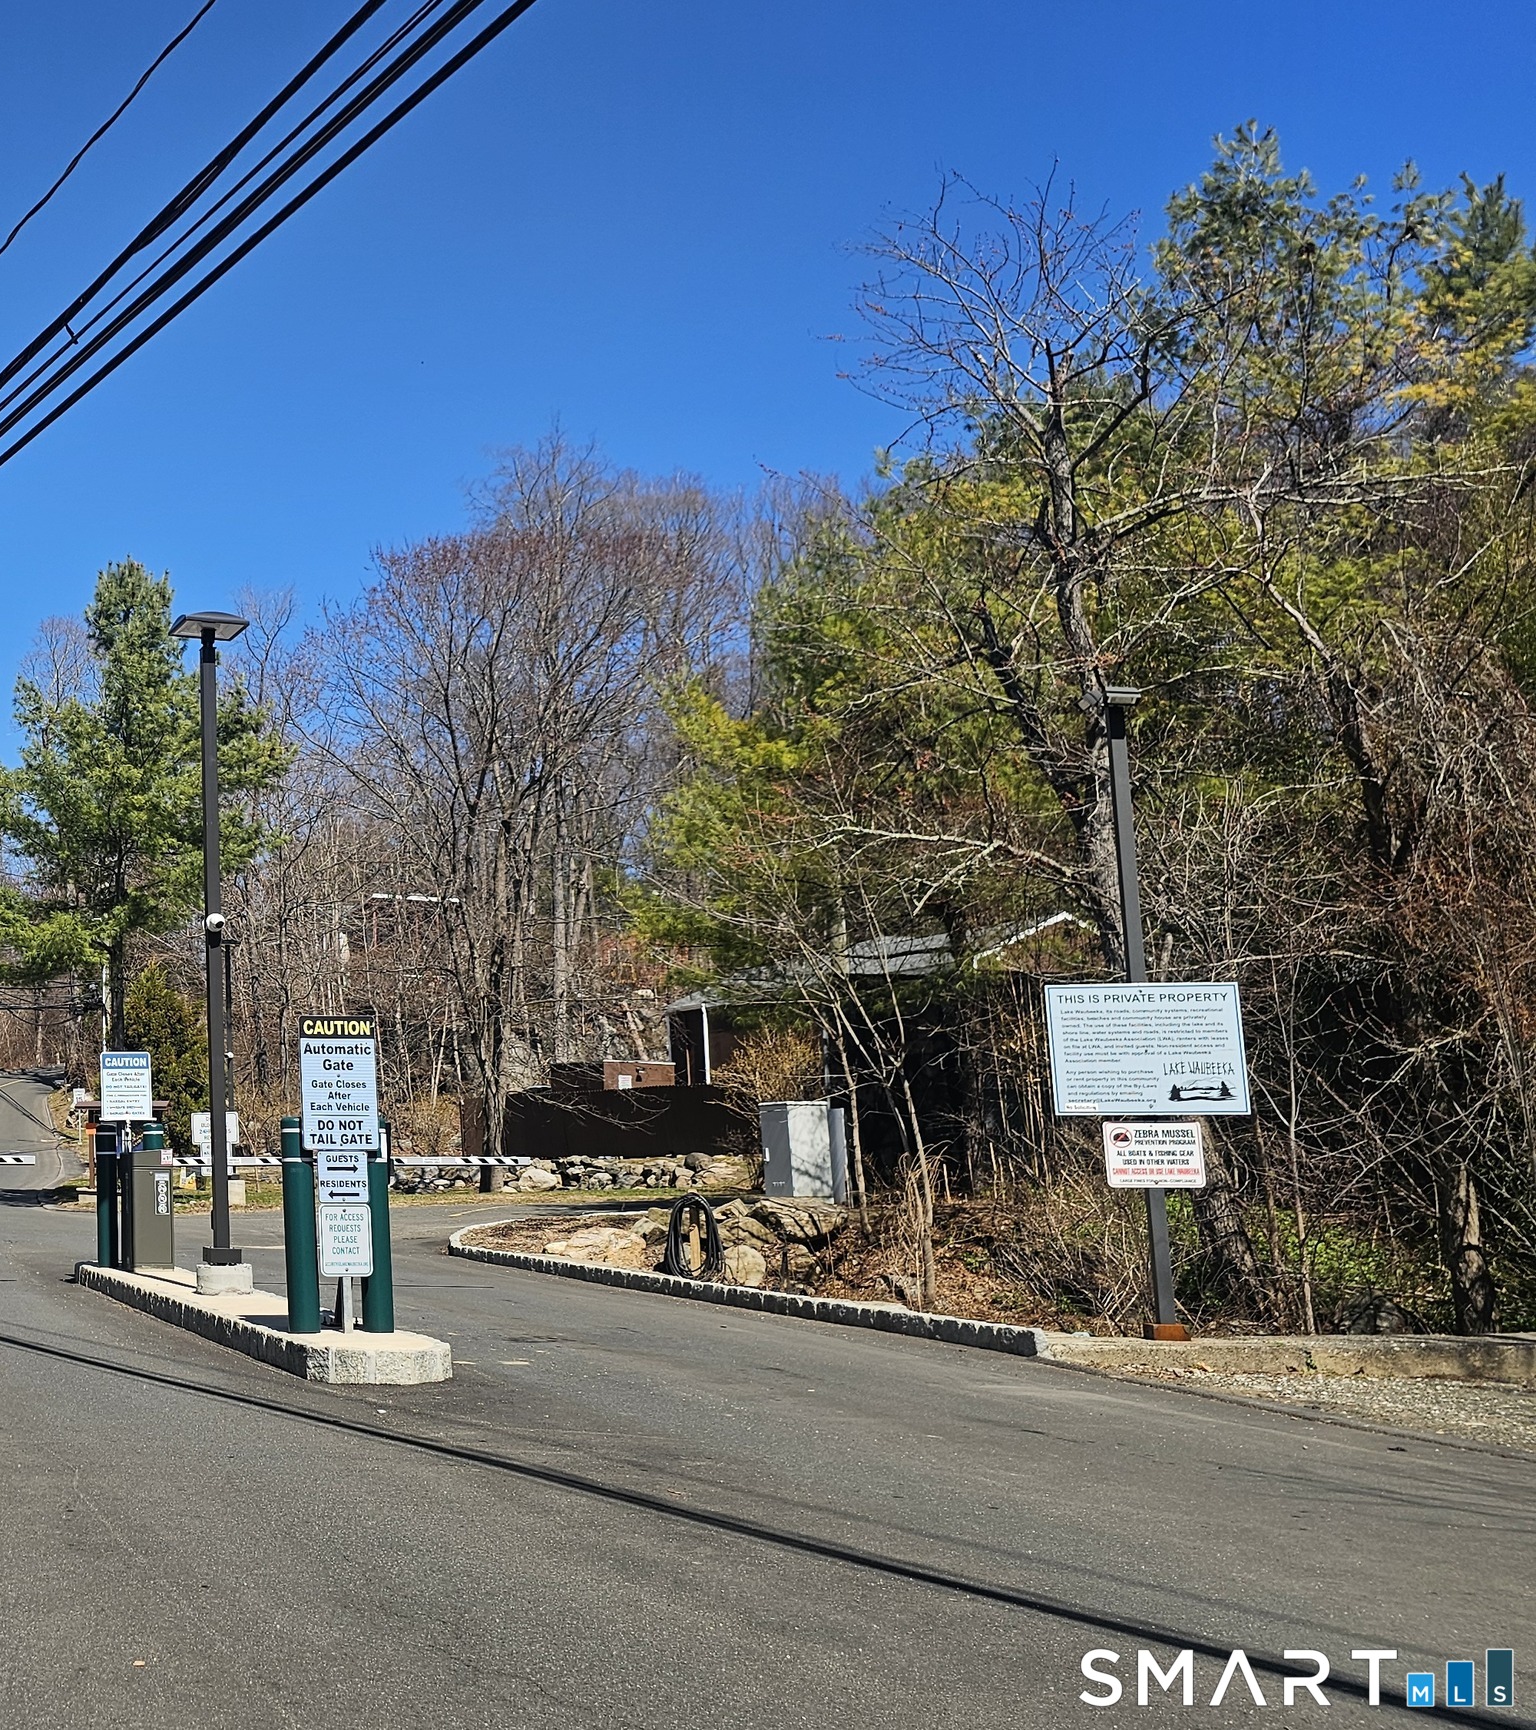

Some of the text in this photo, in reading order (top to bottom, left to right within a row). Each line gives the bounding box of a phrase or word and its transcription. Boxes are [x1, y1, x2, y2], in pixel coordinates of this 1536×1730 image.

[1057, 992, 1228, 1004] THIS IS PRIVATE PROPERTY
[303, 1020, 370, 1036] CAUTION
[304, 1043, 371, 1055] Automatic
[105, 1057, 146, 1067] CAUTION
[323, 1059, 354, 1071] Gate
[1163, 1061, 1235, 1075] LAKE WAUBEEKA
[312, 1080, 366, 1089] Gate Closes
[328, 1091, 351, 1100] After
[310, 1102, 370, 1111] Each Vehicle
[318, 1120, 363, 1130] DO NOT
[1134, 1129, 1195, 1138] ZEBRA MUSSEL
[310, 1134, 372, 1145] TAIL GATE
[326, 1155, 359, 1163] GUESTS
[320, 1180, 367, 1188] RESIDENTS
[329, 1224, 361, 1232] REQUESTS
[334, 1236, 357, 1244] PLEASE
